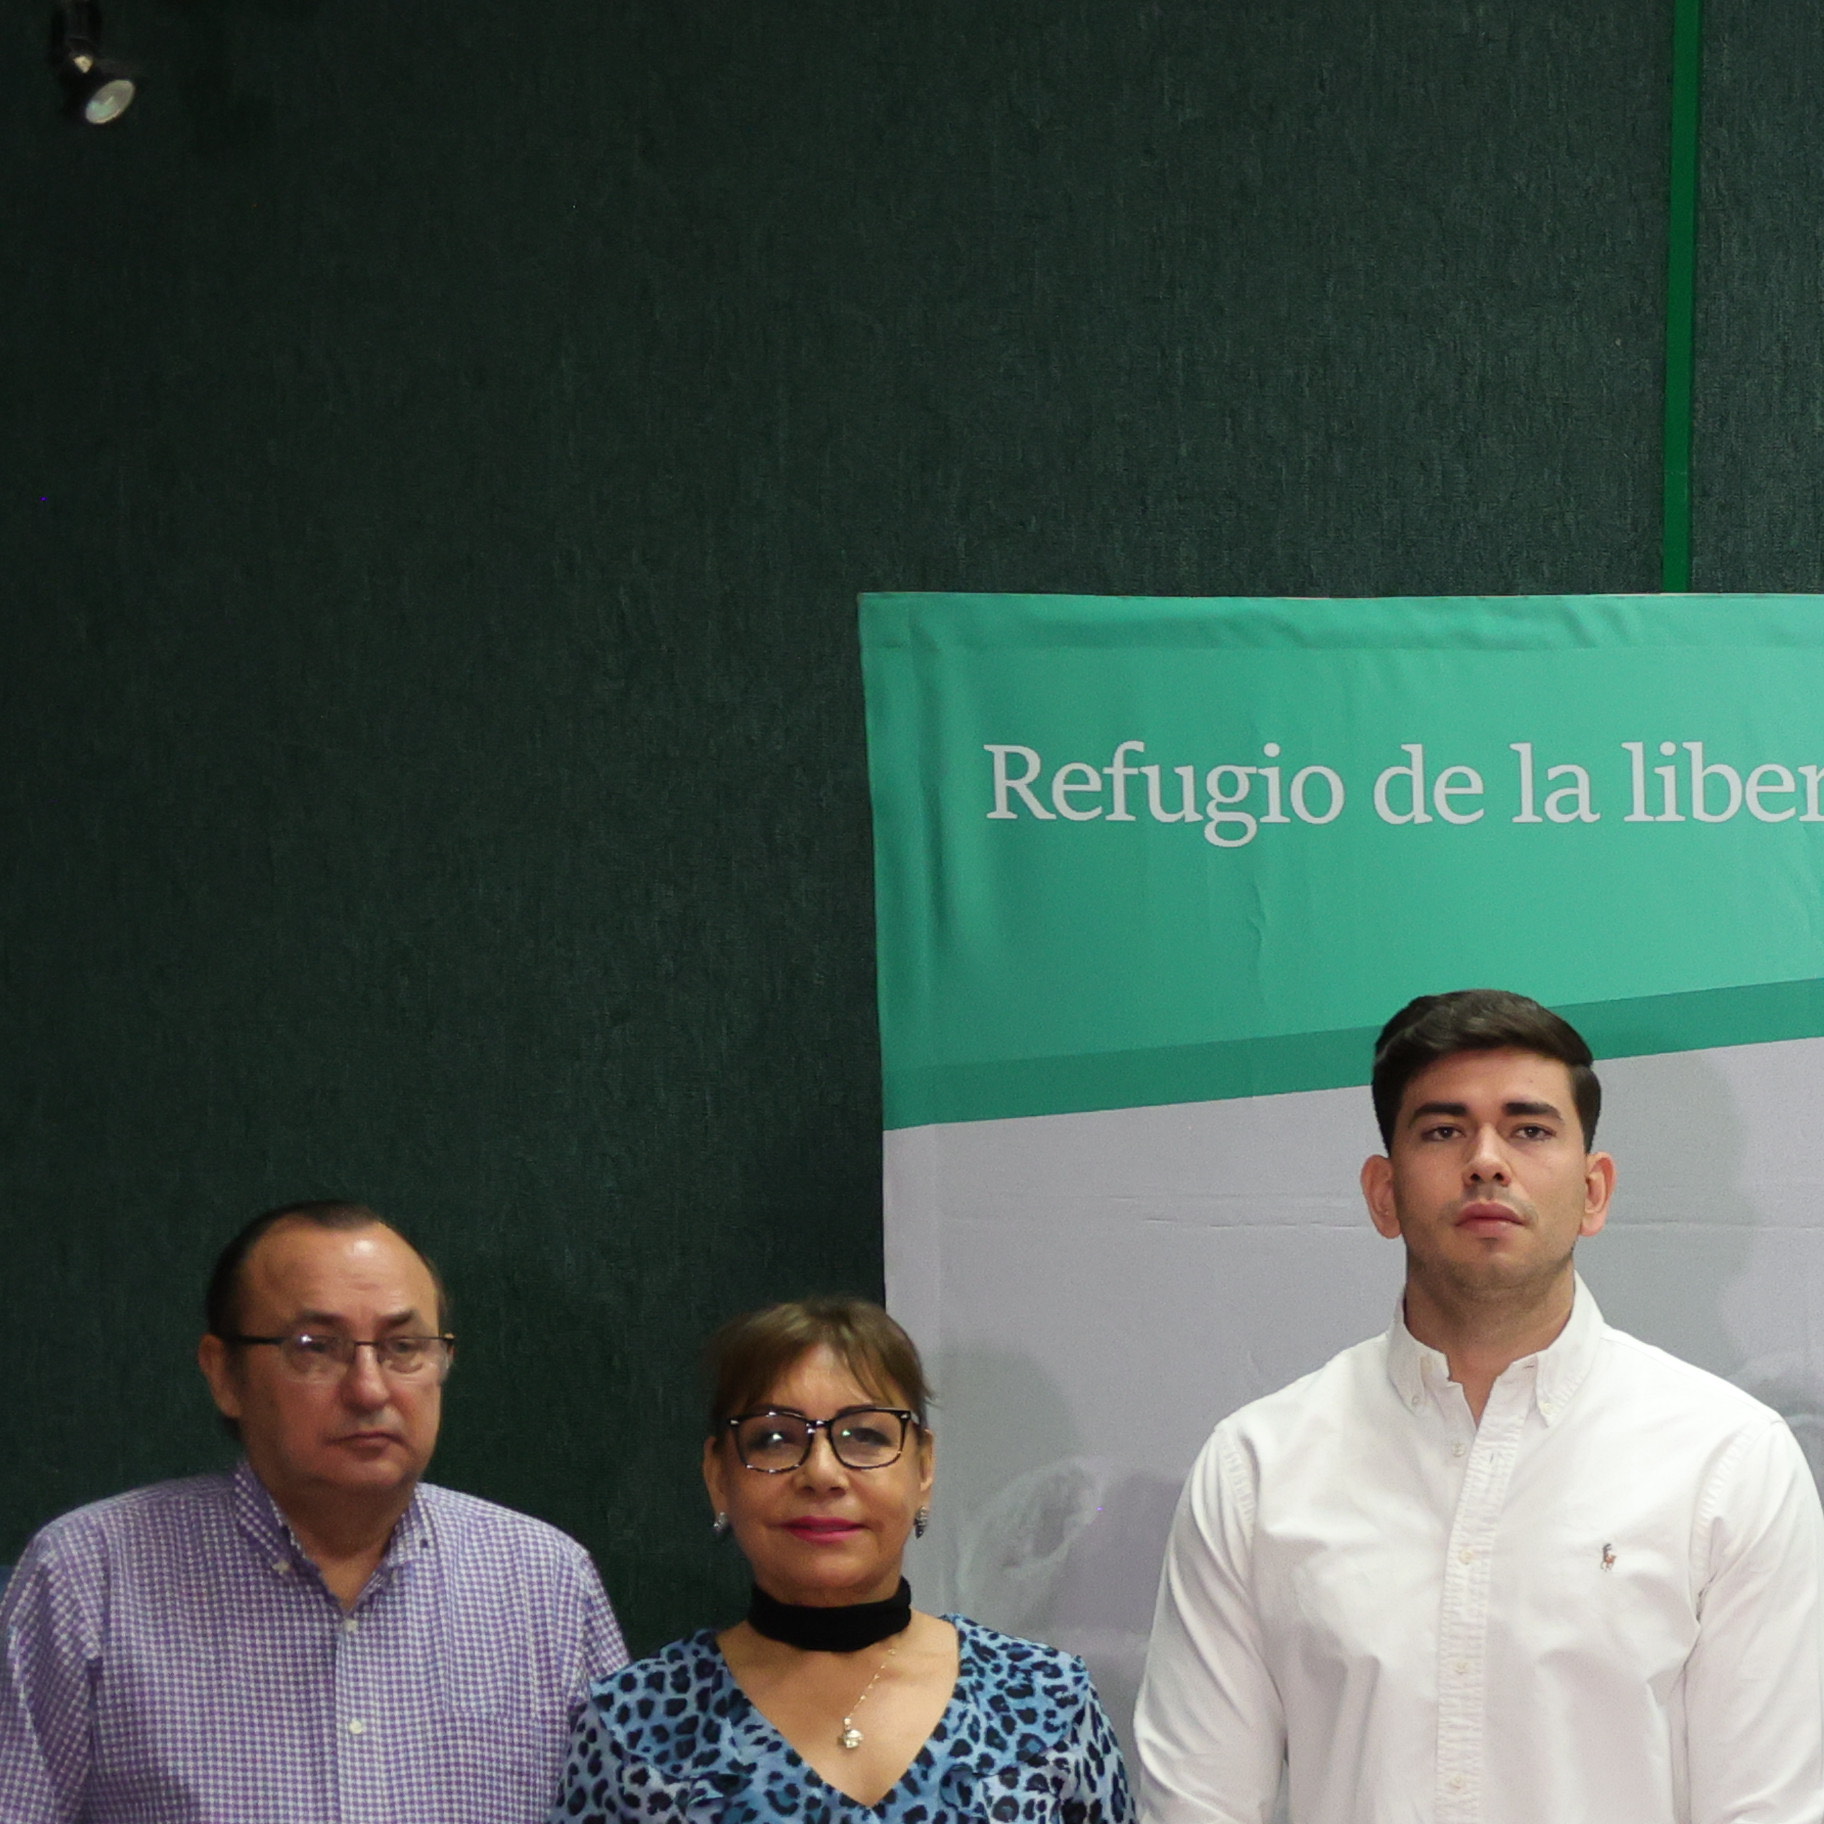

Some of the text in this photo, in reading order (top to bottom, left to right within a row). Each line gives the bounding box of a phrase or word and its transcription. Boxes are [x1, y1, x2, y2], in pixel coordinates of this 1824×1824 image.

[983, 740, 1345, 848] Refugio
[1373, 743, 1485, 825] de
[1509, 742, 1601, 823] la
